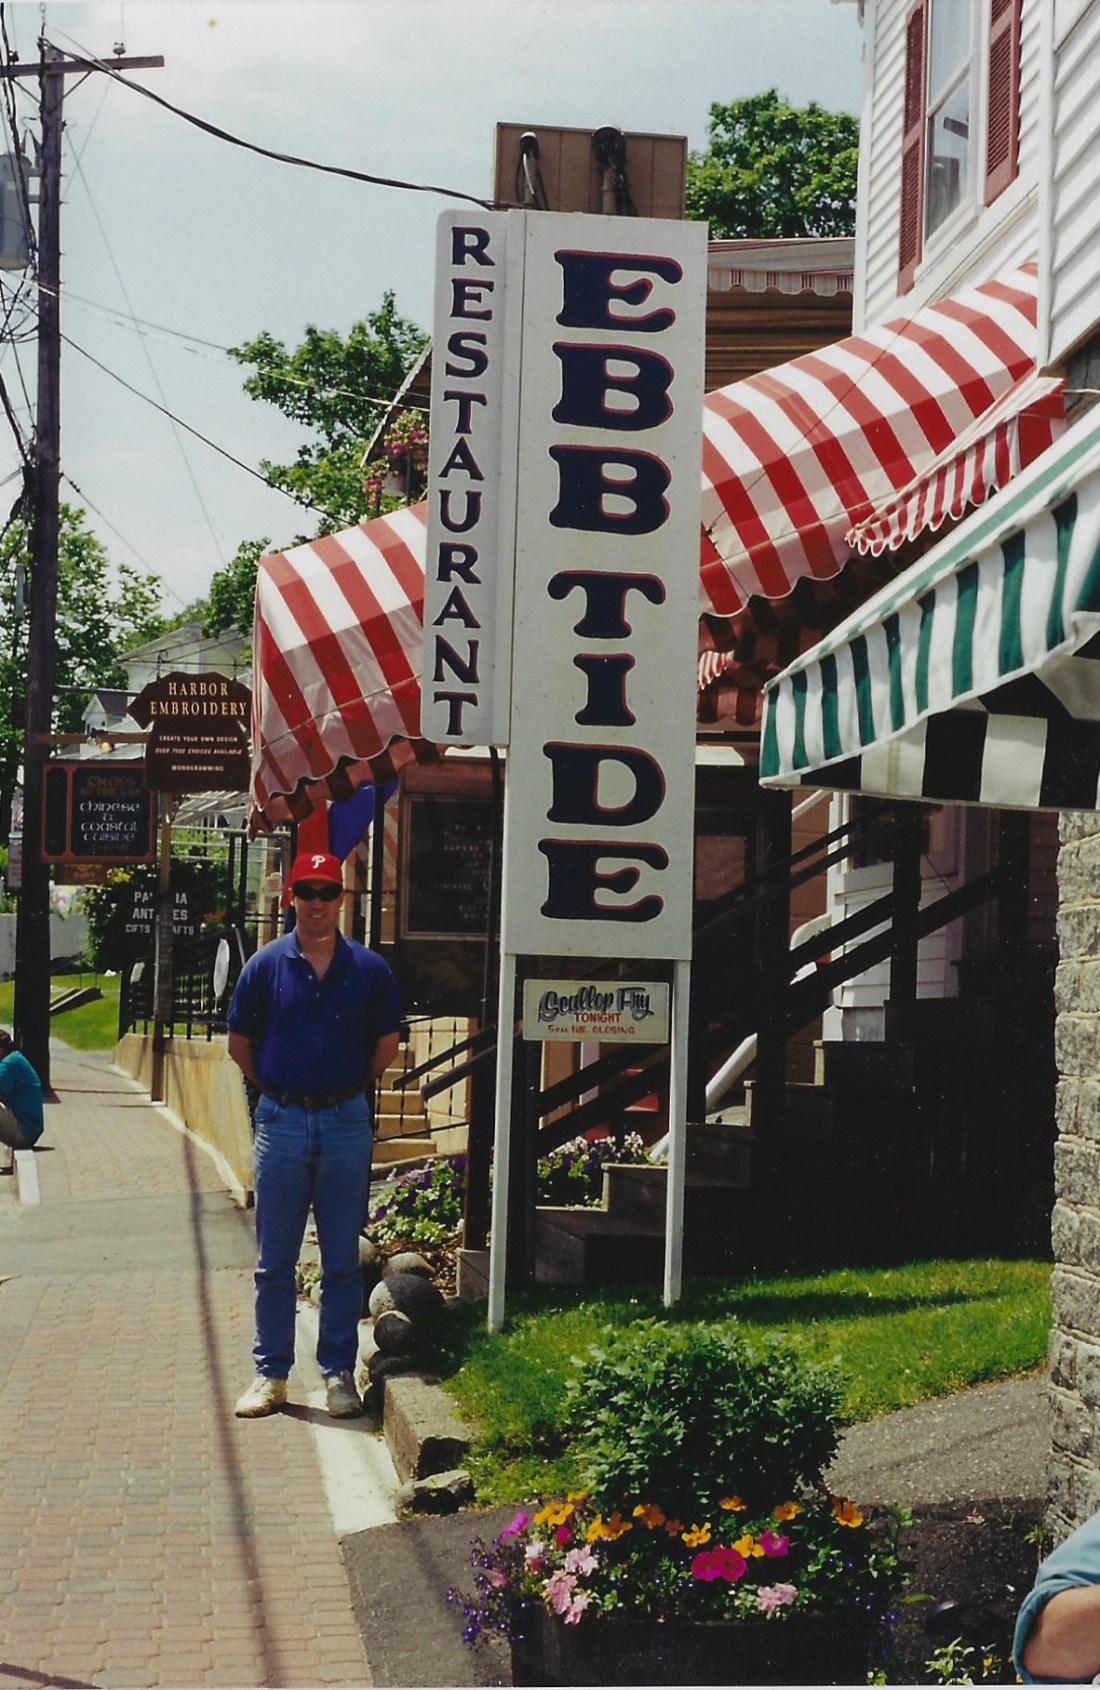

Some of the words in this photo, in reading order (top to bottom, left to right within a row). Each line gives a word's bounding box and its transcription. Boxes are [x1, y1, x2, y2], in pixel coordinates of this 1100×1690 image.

[432, 225, 496, 736] RESTAURANT
[168, 682, 229, 696] HARBOR
[150, 701, 247, 716] EMBROIDERY
[171, 764, 225, 772] MONOGRAMMING
[311, 854, 326, 870] P
[132, 907, 188, 921] ANTES
[538, 985, 614, 1023] Scallop
[616, 986, 655, 1022] Fry
[573, 1012, 622, 1023] TONIGHT
[592, 1025, 635, 1035] CLOSING
